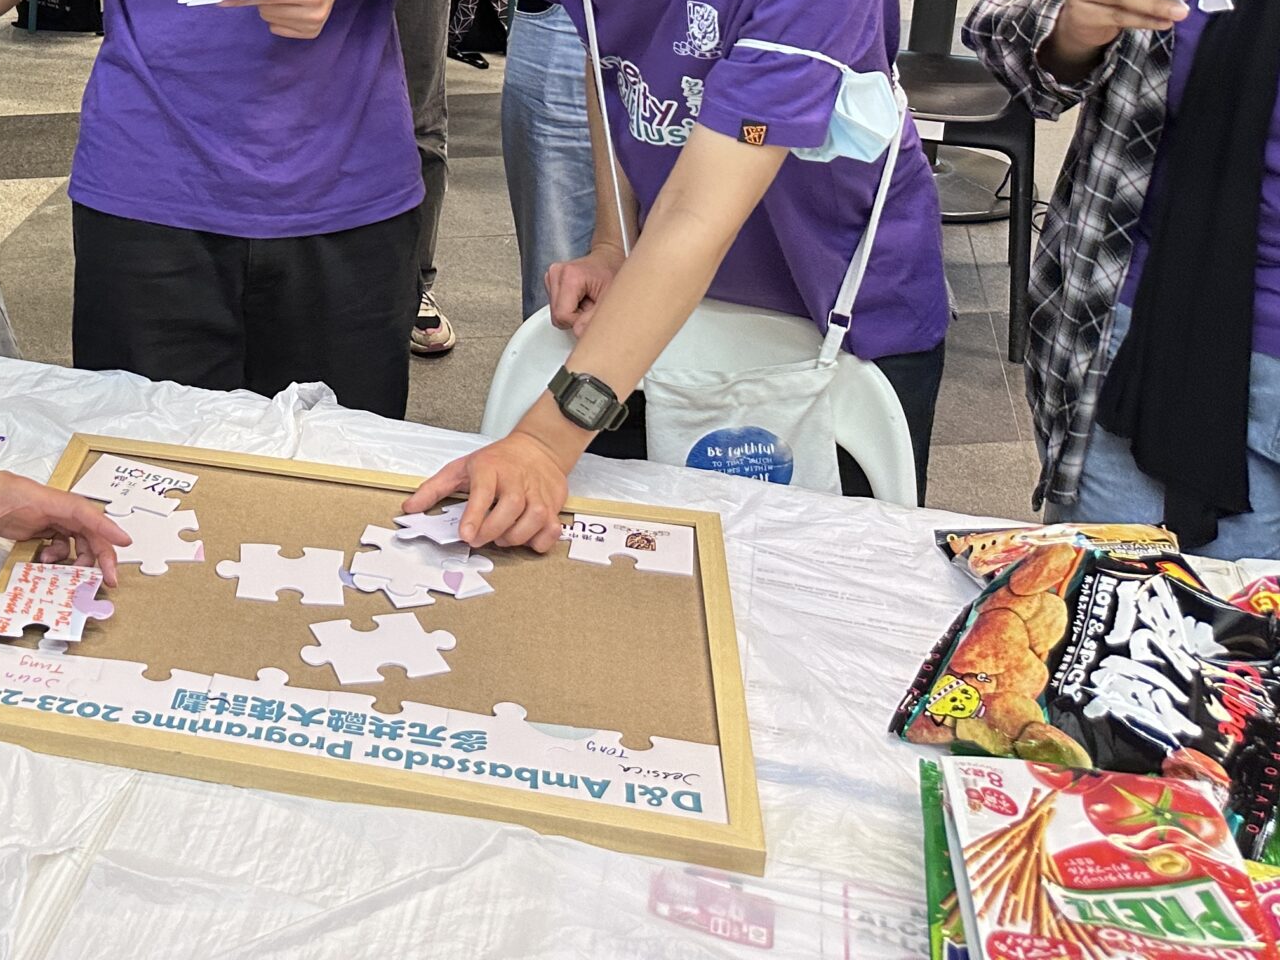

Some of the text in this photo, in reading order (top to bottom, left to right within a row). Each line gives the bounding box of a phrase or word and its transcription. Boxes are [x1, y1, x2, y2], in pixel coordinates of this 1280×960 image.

[726, 458, 745, 467] THAT
[727, 442, 775, 457] faithful
[744, 465, 774, 473] WITHIN
[1062, 575, 1118, 702] HOT & SPICY
[171, 687, 488, 752] 多元共融大使計劃
[1218, 661, 1262, 745] Cabee
[132, 709, 353, 760] Programme
[364, 743, 612, 799] Ambassador
[618, 762, 702, 786] Jessica
[624, 783, 704, 814] D&I
[1063, 890, 1247, 942] PRETZ
